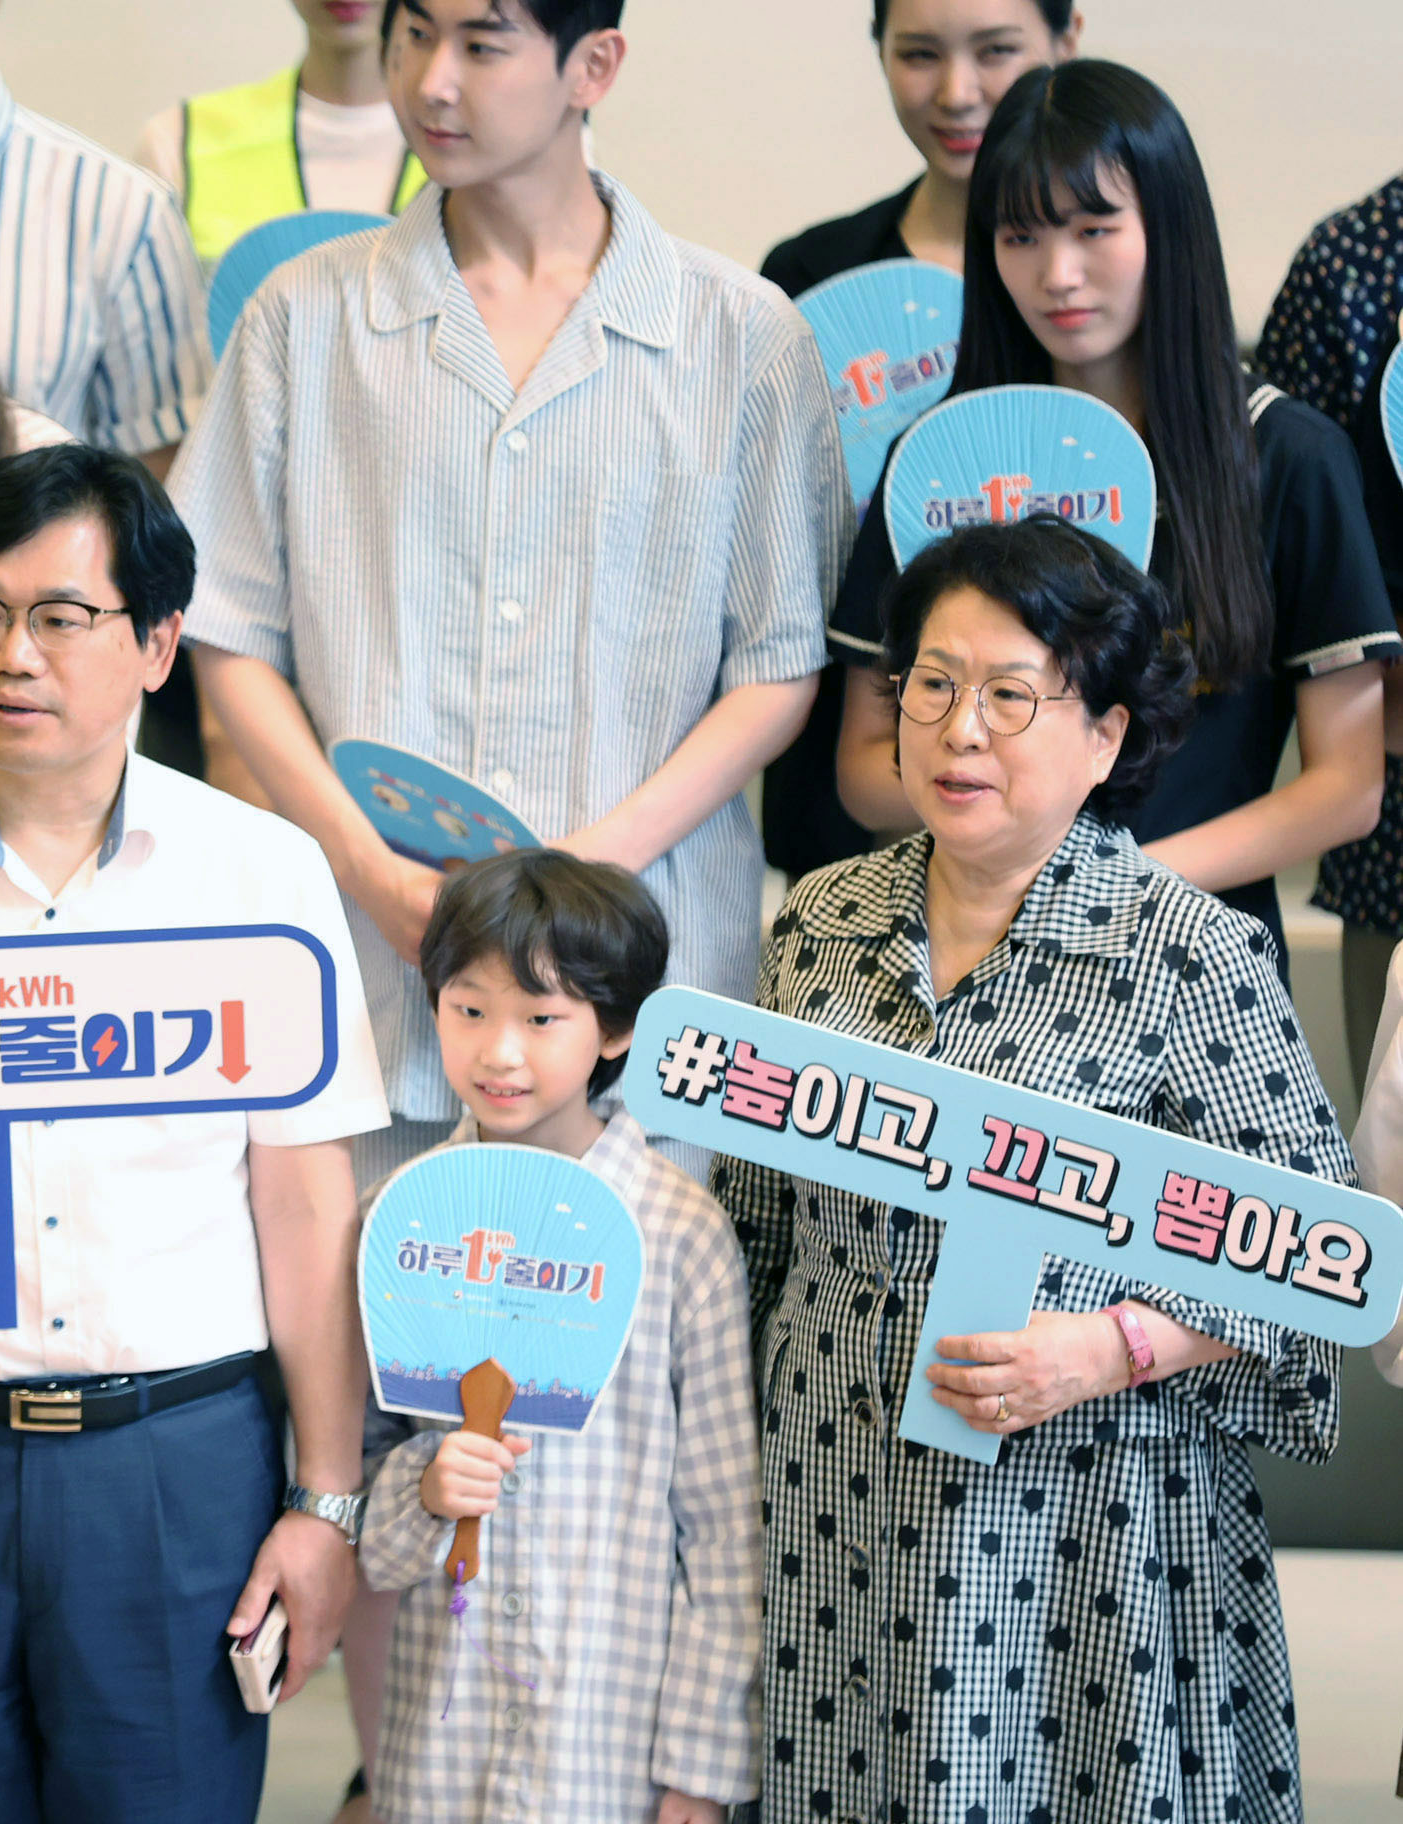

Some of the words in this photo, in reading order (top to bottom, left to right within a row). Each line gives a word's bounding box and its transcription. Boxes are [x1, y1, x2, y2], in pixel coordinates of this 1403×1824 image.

[656, 1025, 949, 1191] #높이고,
[967, 1114, 1132, 1246] 끄고,
[1153, 1170, 1372, 1308] 뽑아요
[398, 1240, 463, 1277] 하루
[504, 1255, 605, 1303] 줄이기
